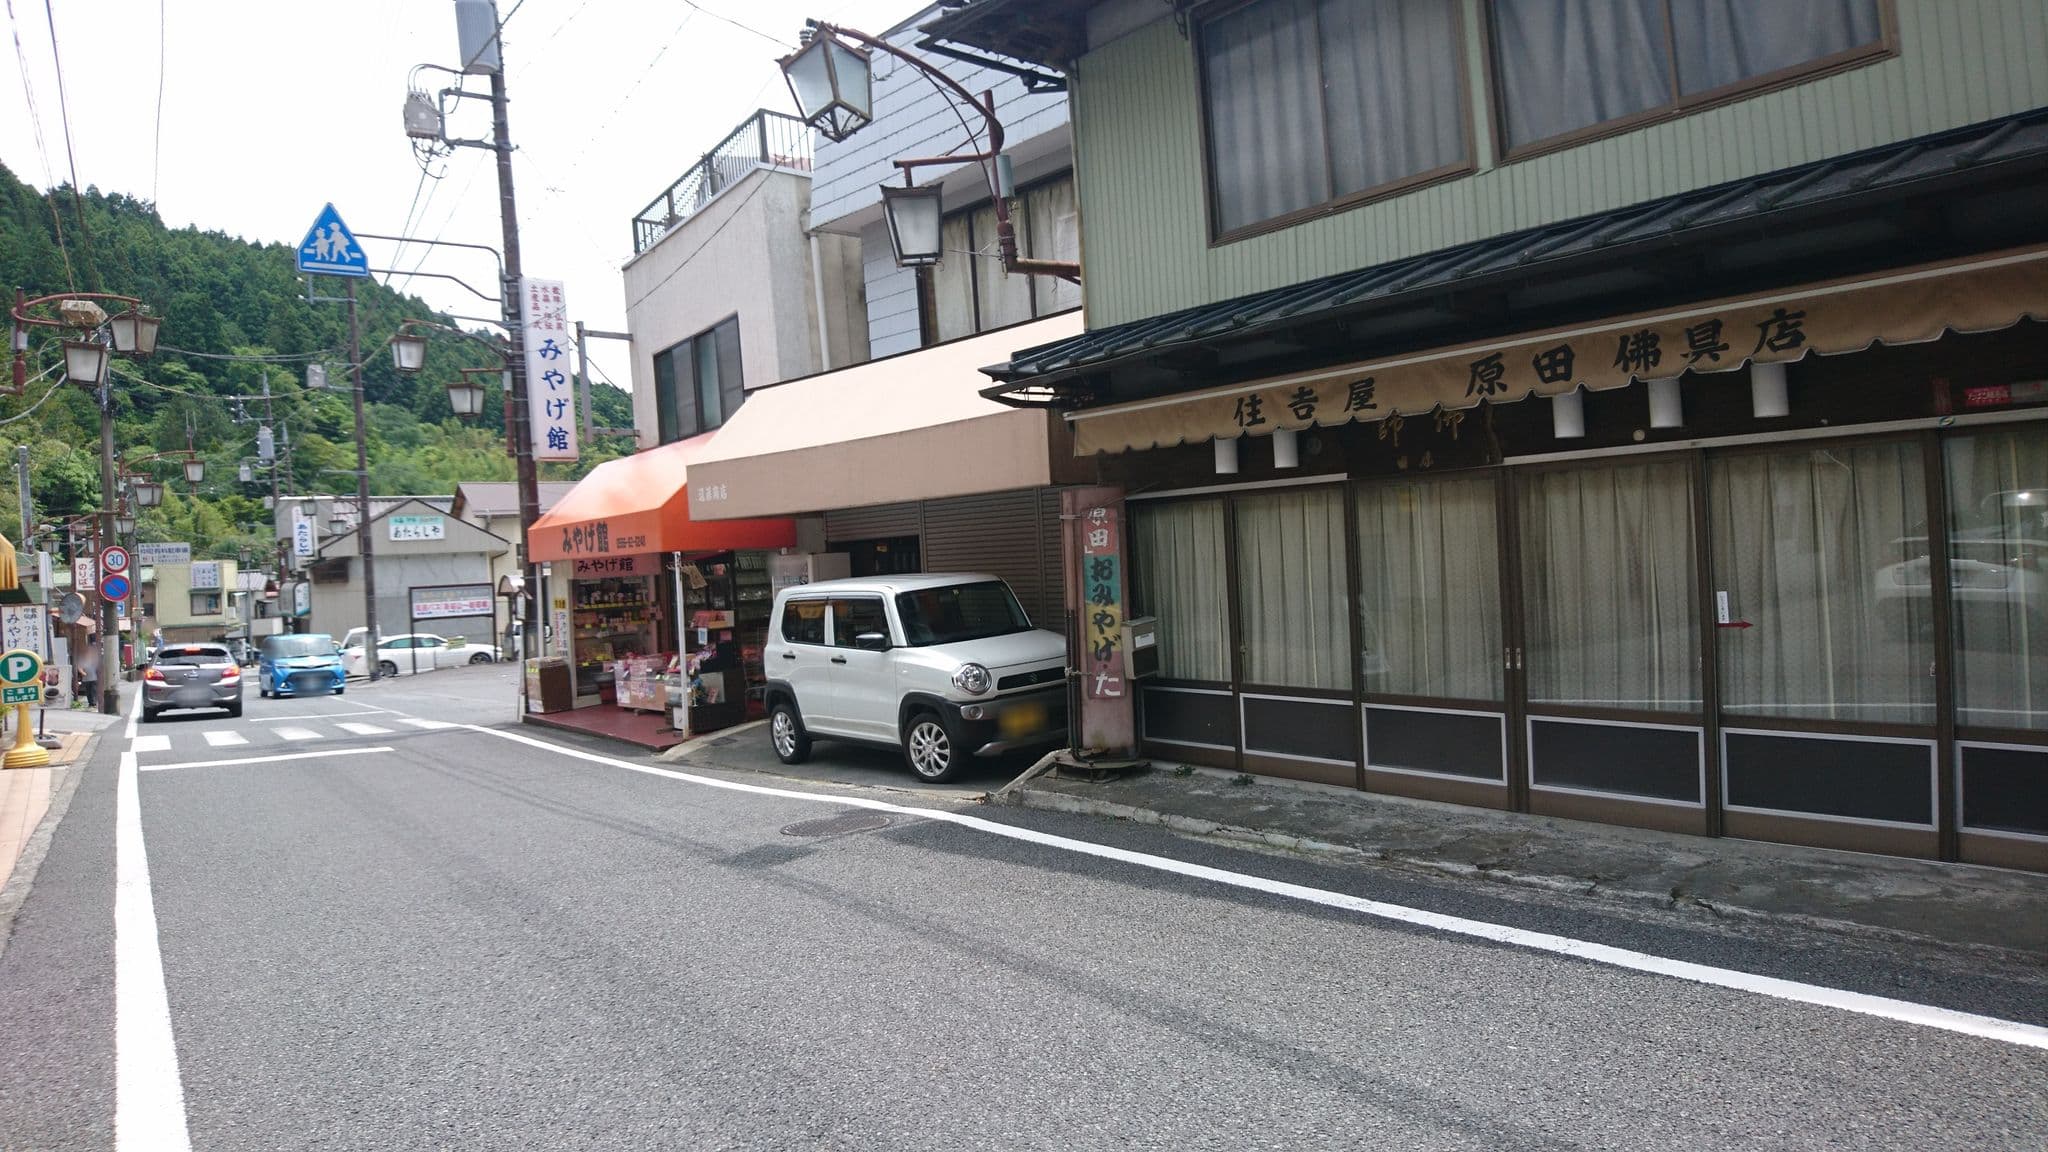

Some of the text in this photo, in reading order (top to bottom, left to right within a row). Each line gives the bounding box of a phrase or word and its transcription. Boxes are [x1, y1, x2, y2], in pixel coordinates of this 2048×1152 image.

[1233, 377, 1377, 428] 住吉屋
[1465, 308, 1806, 399] 原田佛具店
[538, 338, 570, 451] みやげ館
[393, 525, 441, 538] あたらしや
[562, 520, 610, 554] みやげ館
[108, 554, 123, 566] 30
[577, 557, 634, 572] みやげ館
[78, 563, 88, 585] のりば
[7, 656, 32, 681] P
